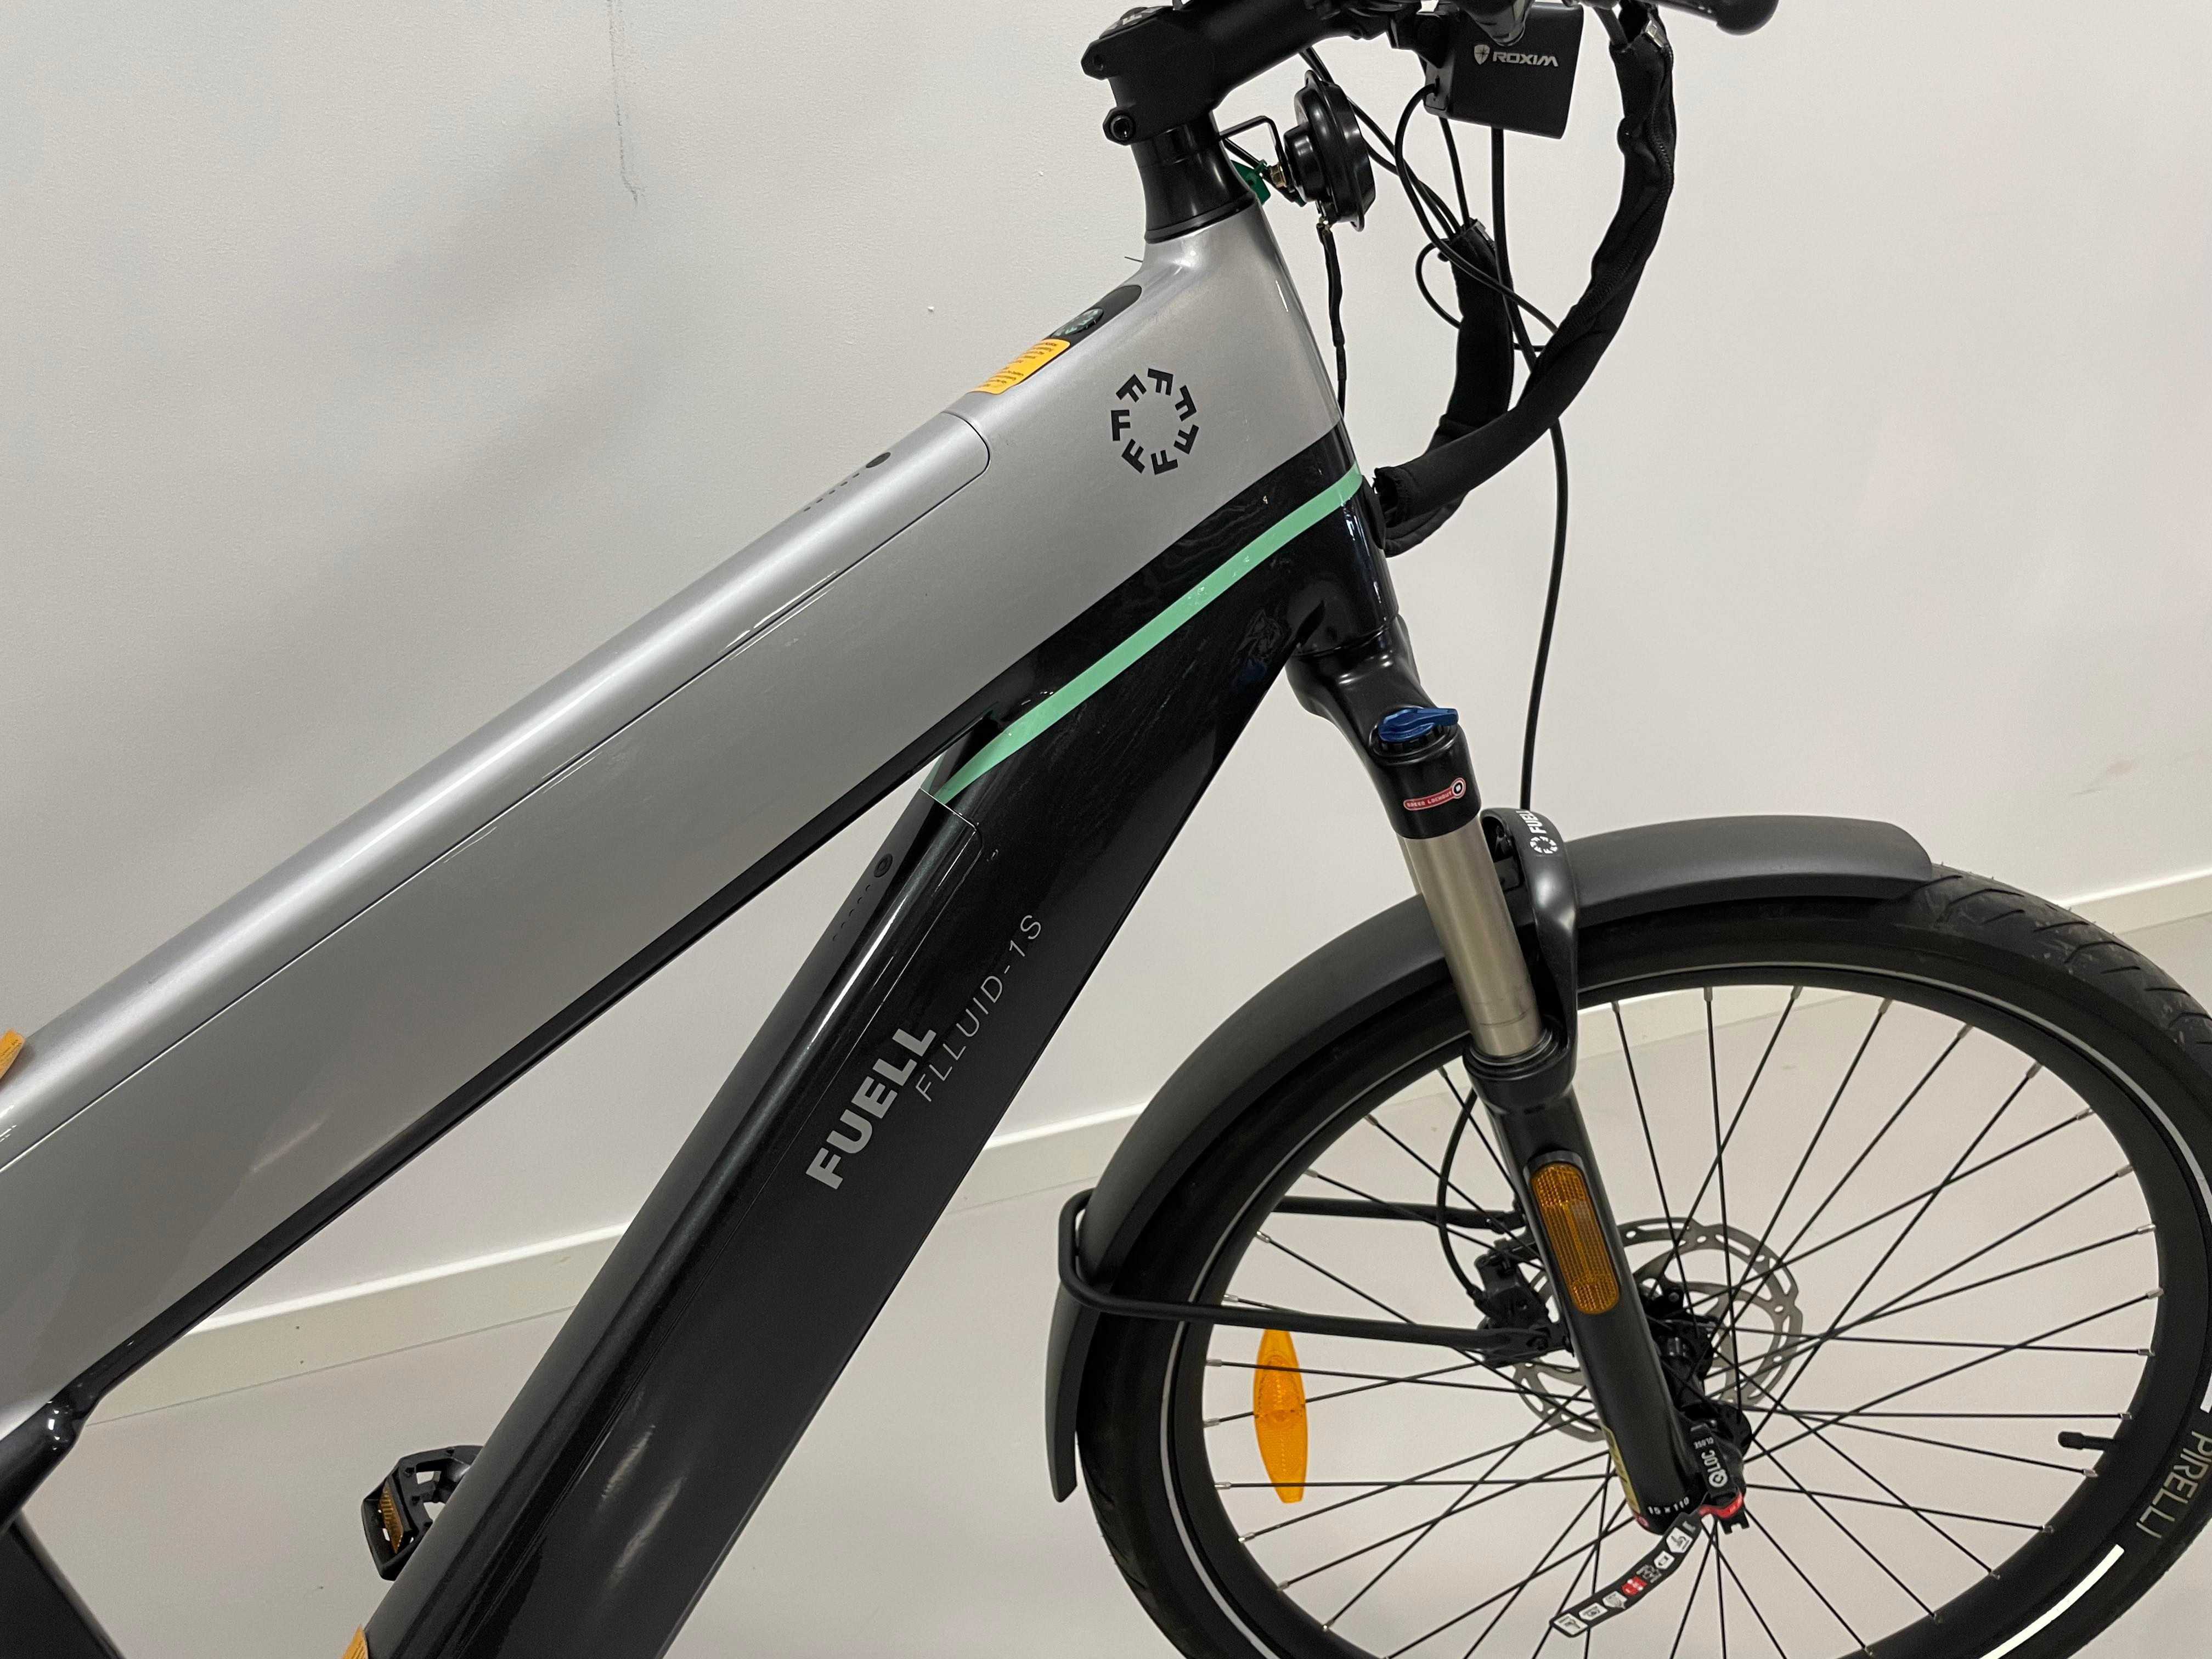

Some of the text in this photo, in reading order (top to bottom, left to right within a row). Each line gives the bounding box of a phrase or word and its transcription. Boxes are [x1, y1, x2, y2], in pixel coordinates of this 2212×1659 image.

[1492, 51, 1559, 67] ROXIM
[916, 915, 1042, 1102] FLLUID-1S
[805, 1028, 936, 1189] FUELL
[2136, 1430, 2212, 1538] PIRELLI
